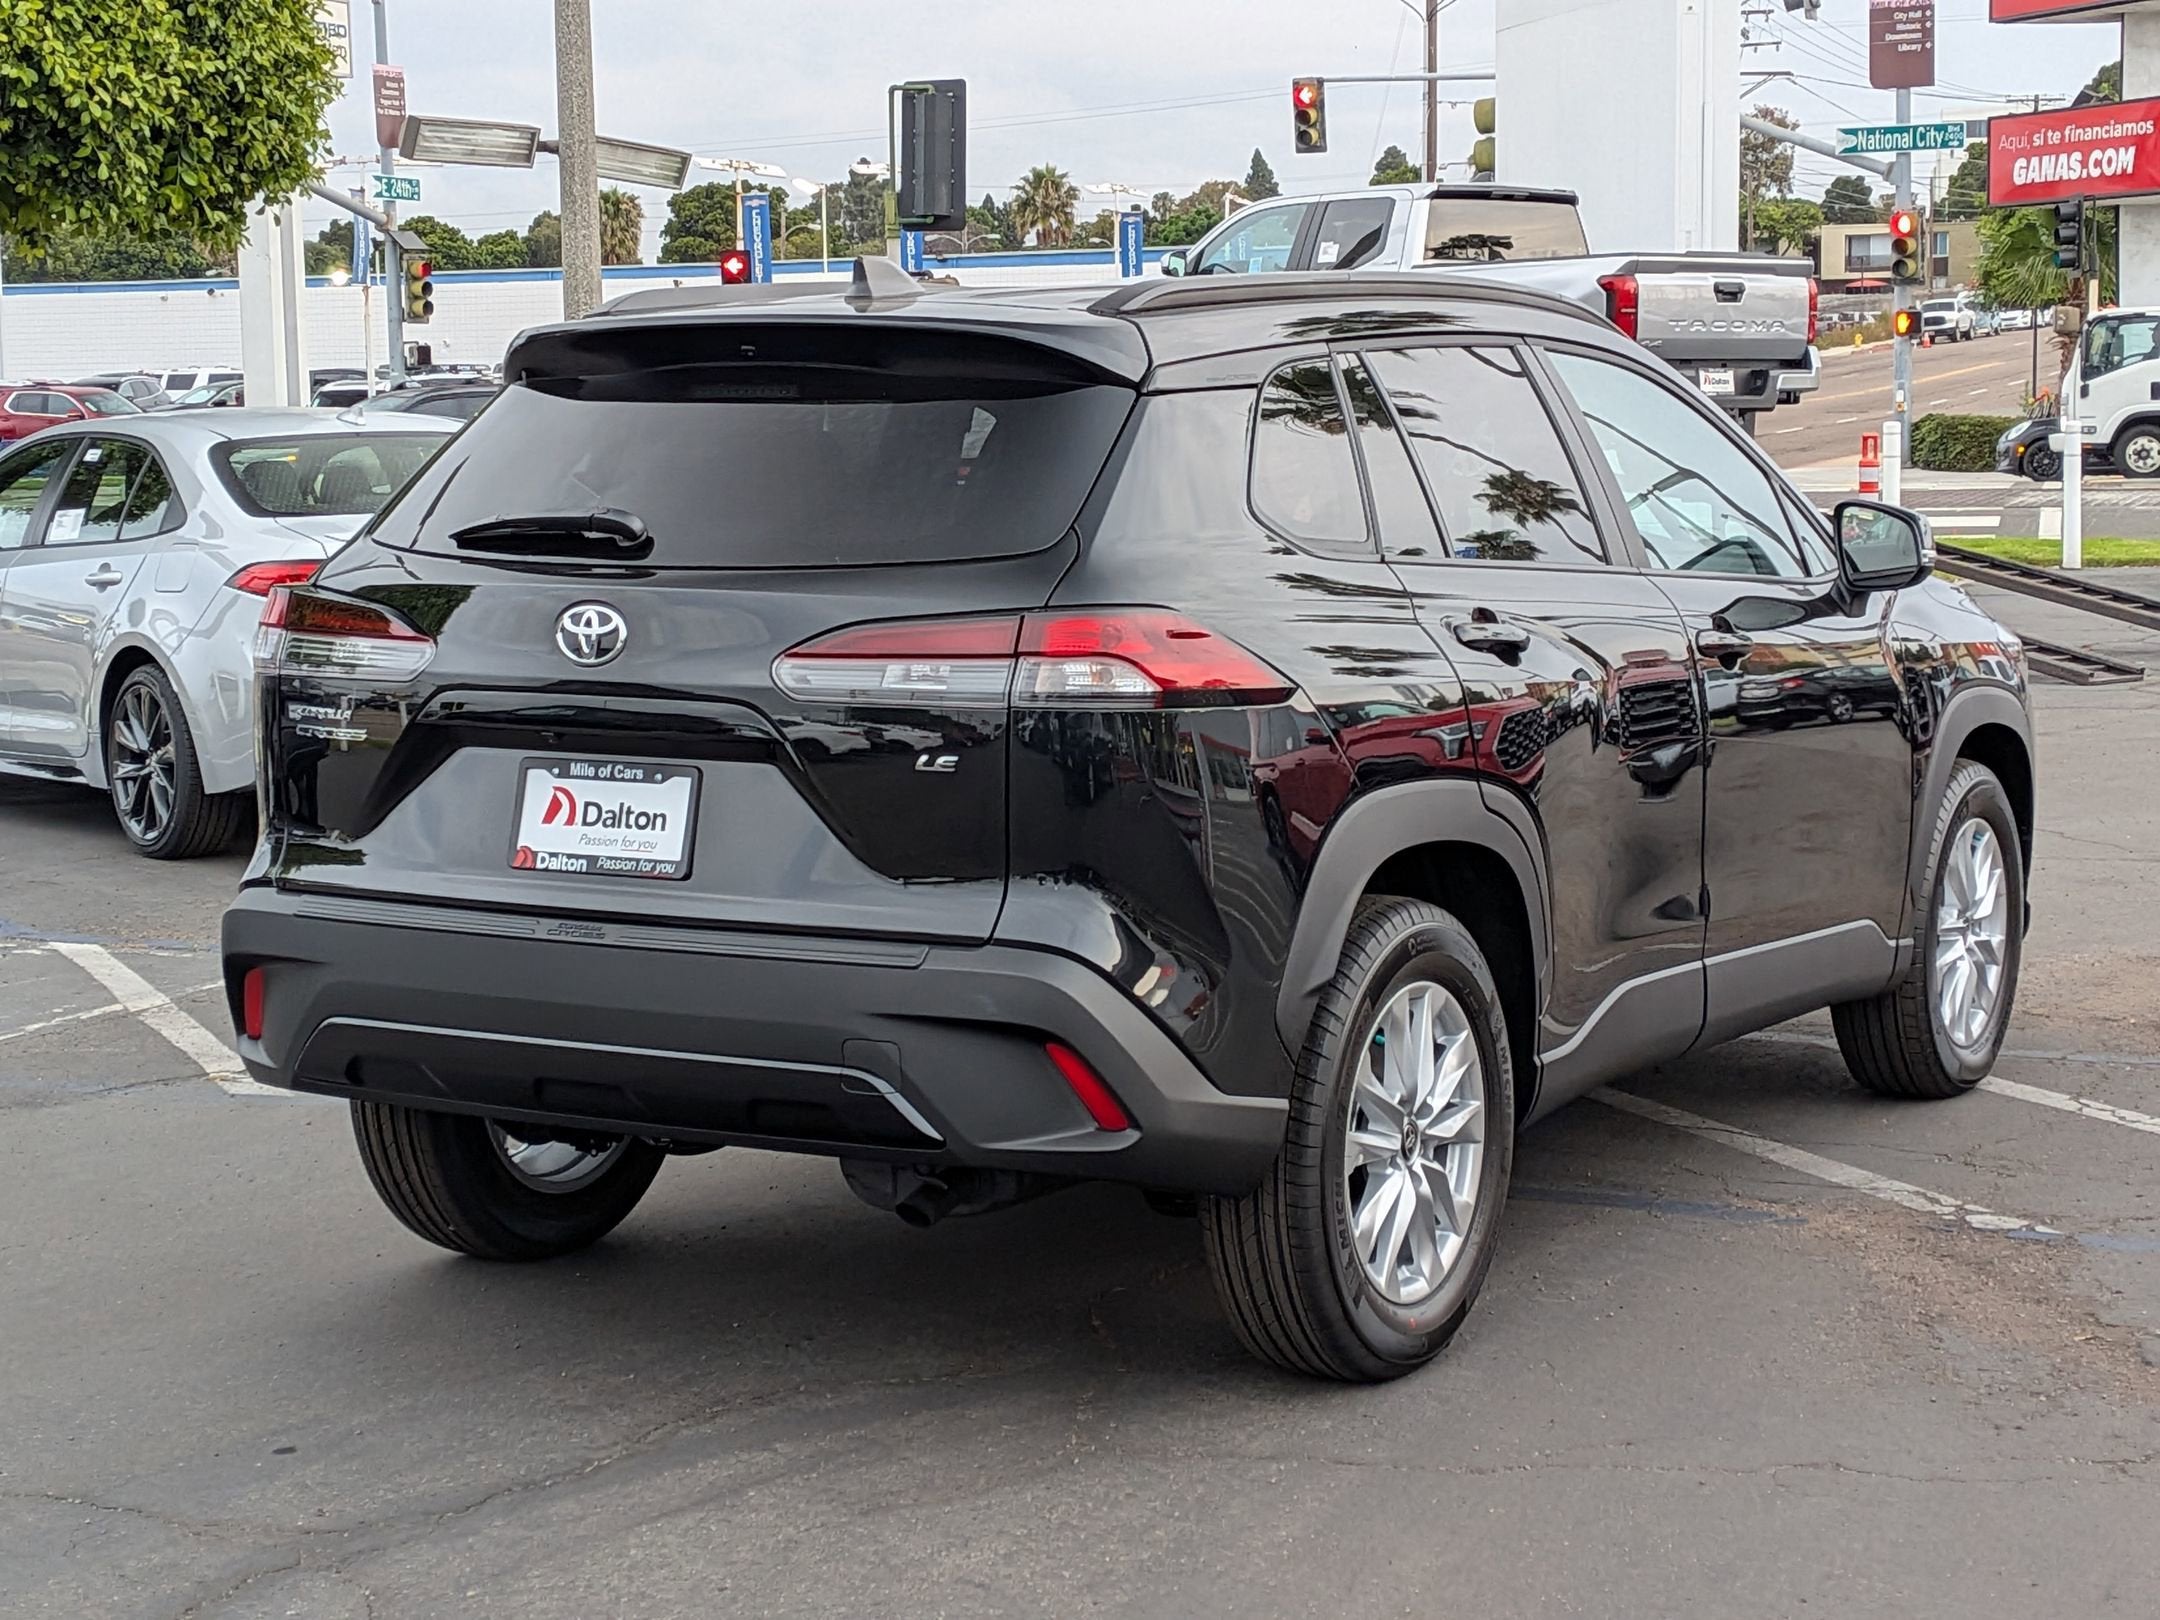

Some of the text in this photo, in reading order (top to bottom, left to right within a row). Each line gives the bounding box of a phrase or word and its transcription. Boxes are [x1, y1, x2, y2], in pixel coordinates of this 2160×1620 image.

[1893, 11, 1907, 21] City
[1898, 43, 1922, 52] Library
[1857, 128, 1913, 151] National
[1916, 126, 1944, 148] City
[1999, 119, 2154, 152] Aquí, sí te financiamos
[2013, 146, 2136, 186] GANAS.COM
[382, 179, 390, 197] E
[391, 180, 412, 198] 24th
[1668, 319, 1786, 333] TACOMA
[569, 762, 644, 780] Mile of Cars
[915, 754, 959, 772] LE
[581, 801, 667, 832] Dalton
[578, 833, 658, 851] Passion for you
[536, 852, 676, 876] Dalton Passion for you
